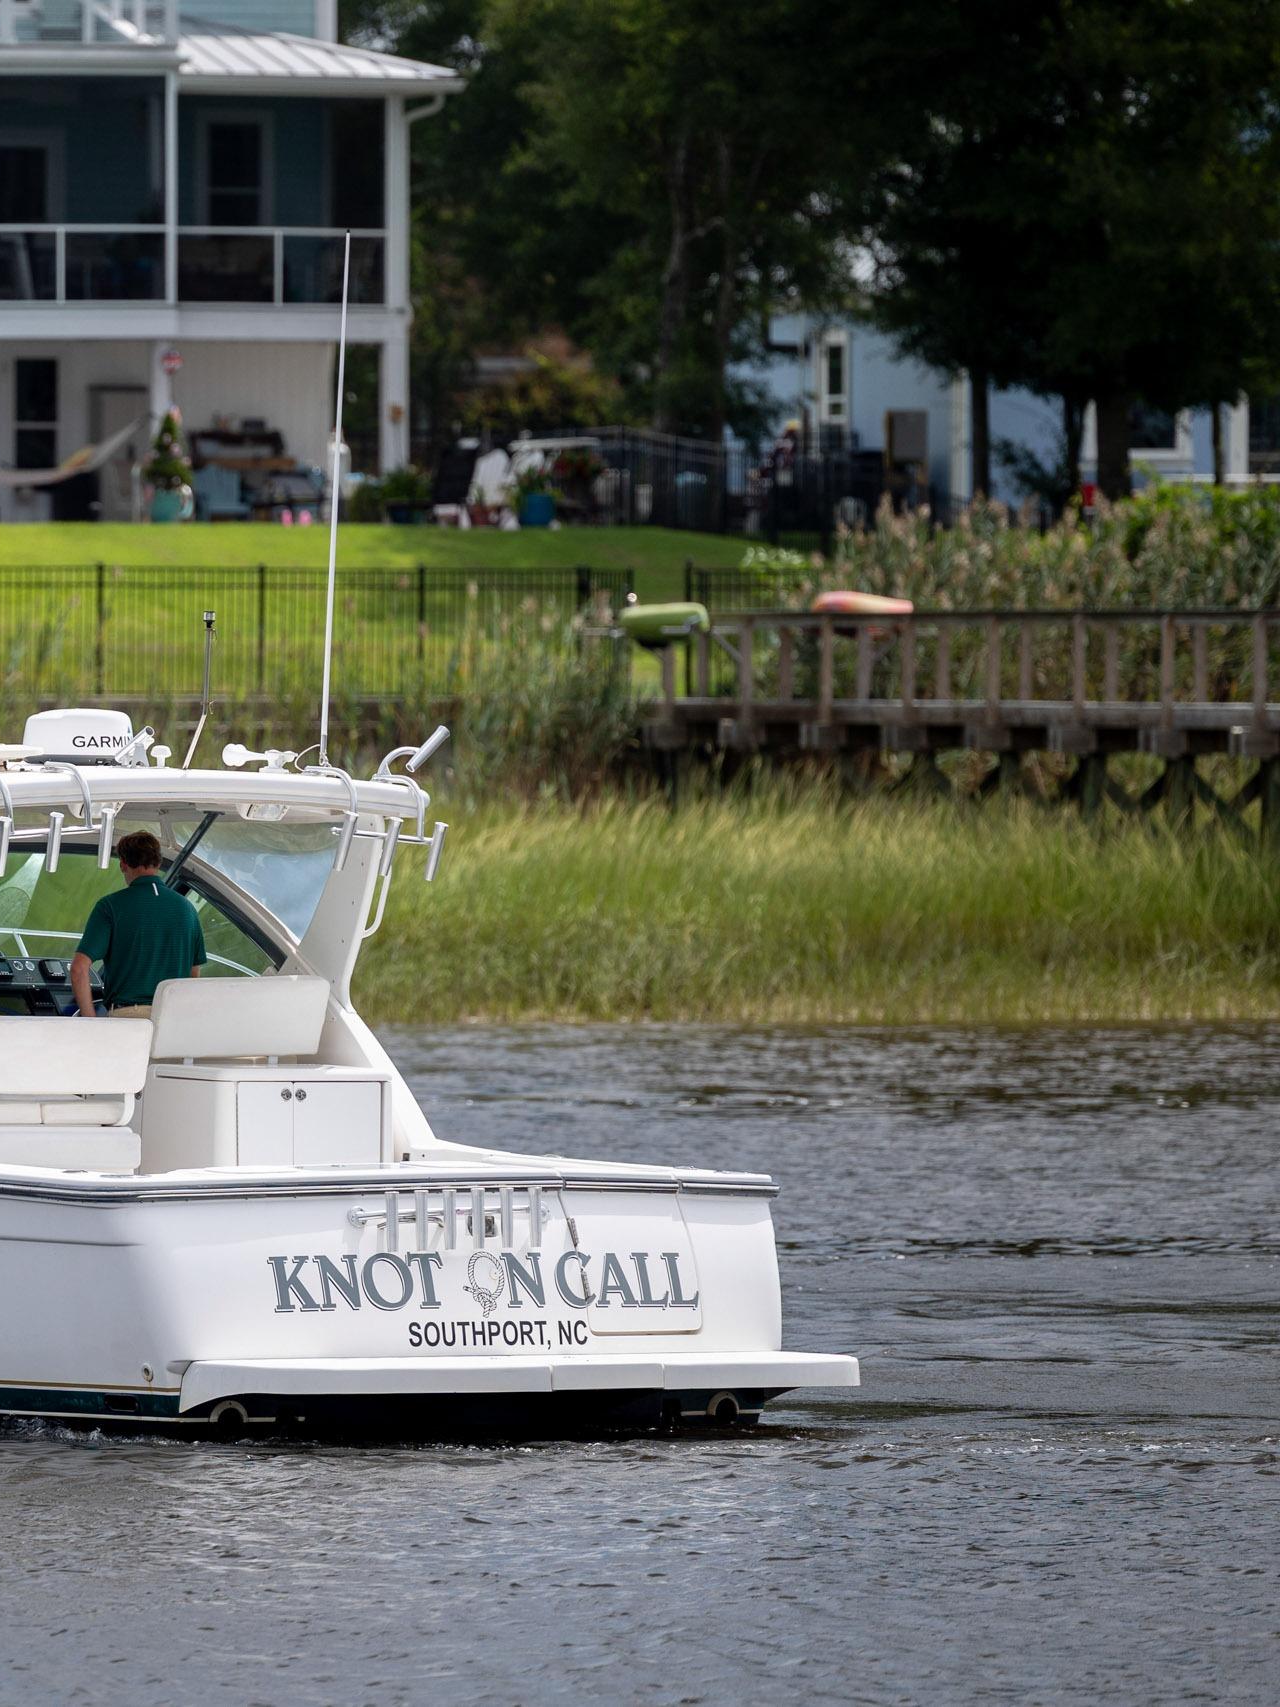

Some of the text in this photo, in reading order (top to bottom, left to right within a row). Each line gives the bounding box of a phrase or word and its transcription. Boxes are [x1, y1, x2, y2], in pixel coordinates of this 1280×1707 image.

[267, 1250, 700, 1318] KNOT ON CALL
[408, 1319, 589, 1349] SOUTHPORT, NC
